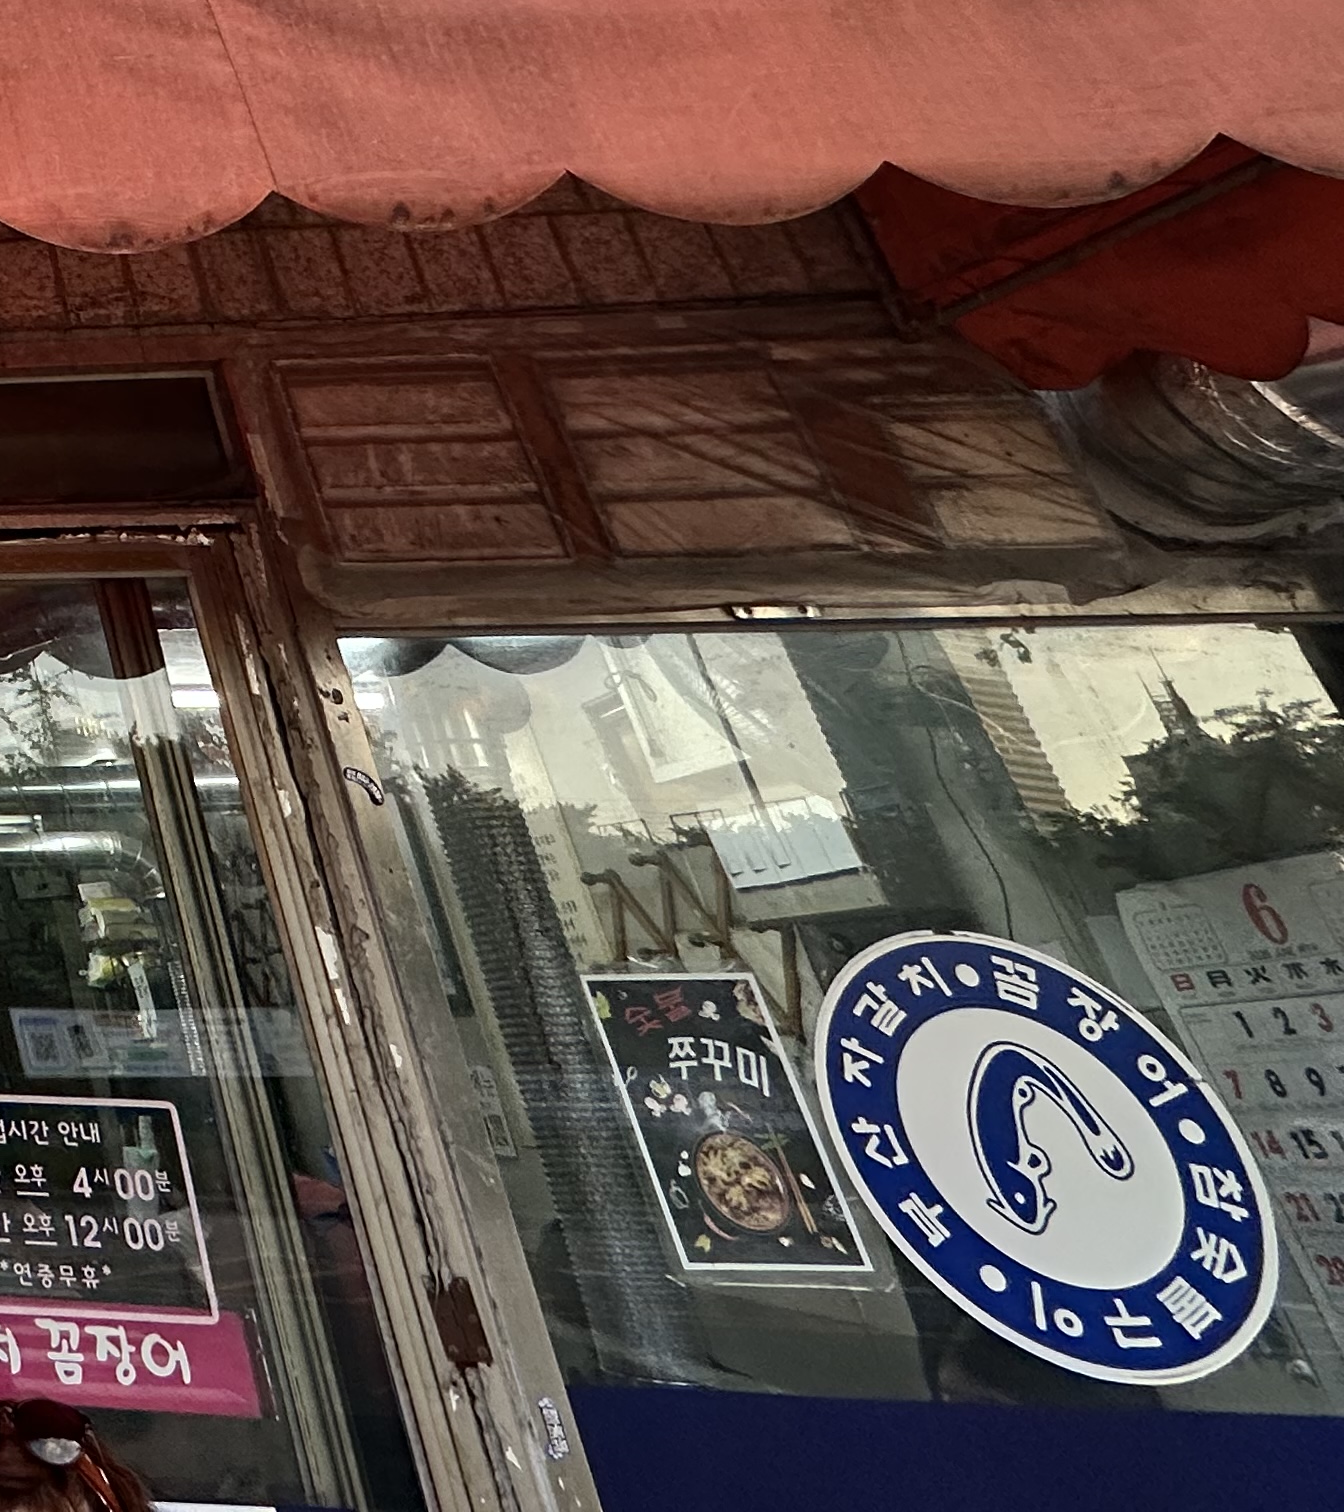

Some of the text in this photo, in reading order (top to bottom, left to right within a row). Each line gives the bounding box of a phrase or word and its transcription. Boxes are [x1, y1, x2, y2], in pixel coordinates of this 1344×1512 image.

[1242, 883, 1288, 945] 6
[1233, 1010, 1254, 1038] 1
[1272, 1006, 1297, 1035] 2
[668, 1036, 770, 1097] 쭈꾸미
[58, 1121, 100, 1147] 안내
[14, 1163, 47, 1186] 오후
[22, 1213, 55, 1236] 오후
[35, 1316, 192, 1386] 꼼장어
